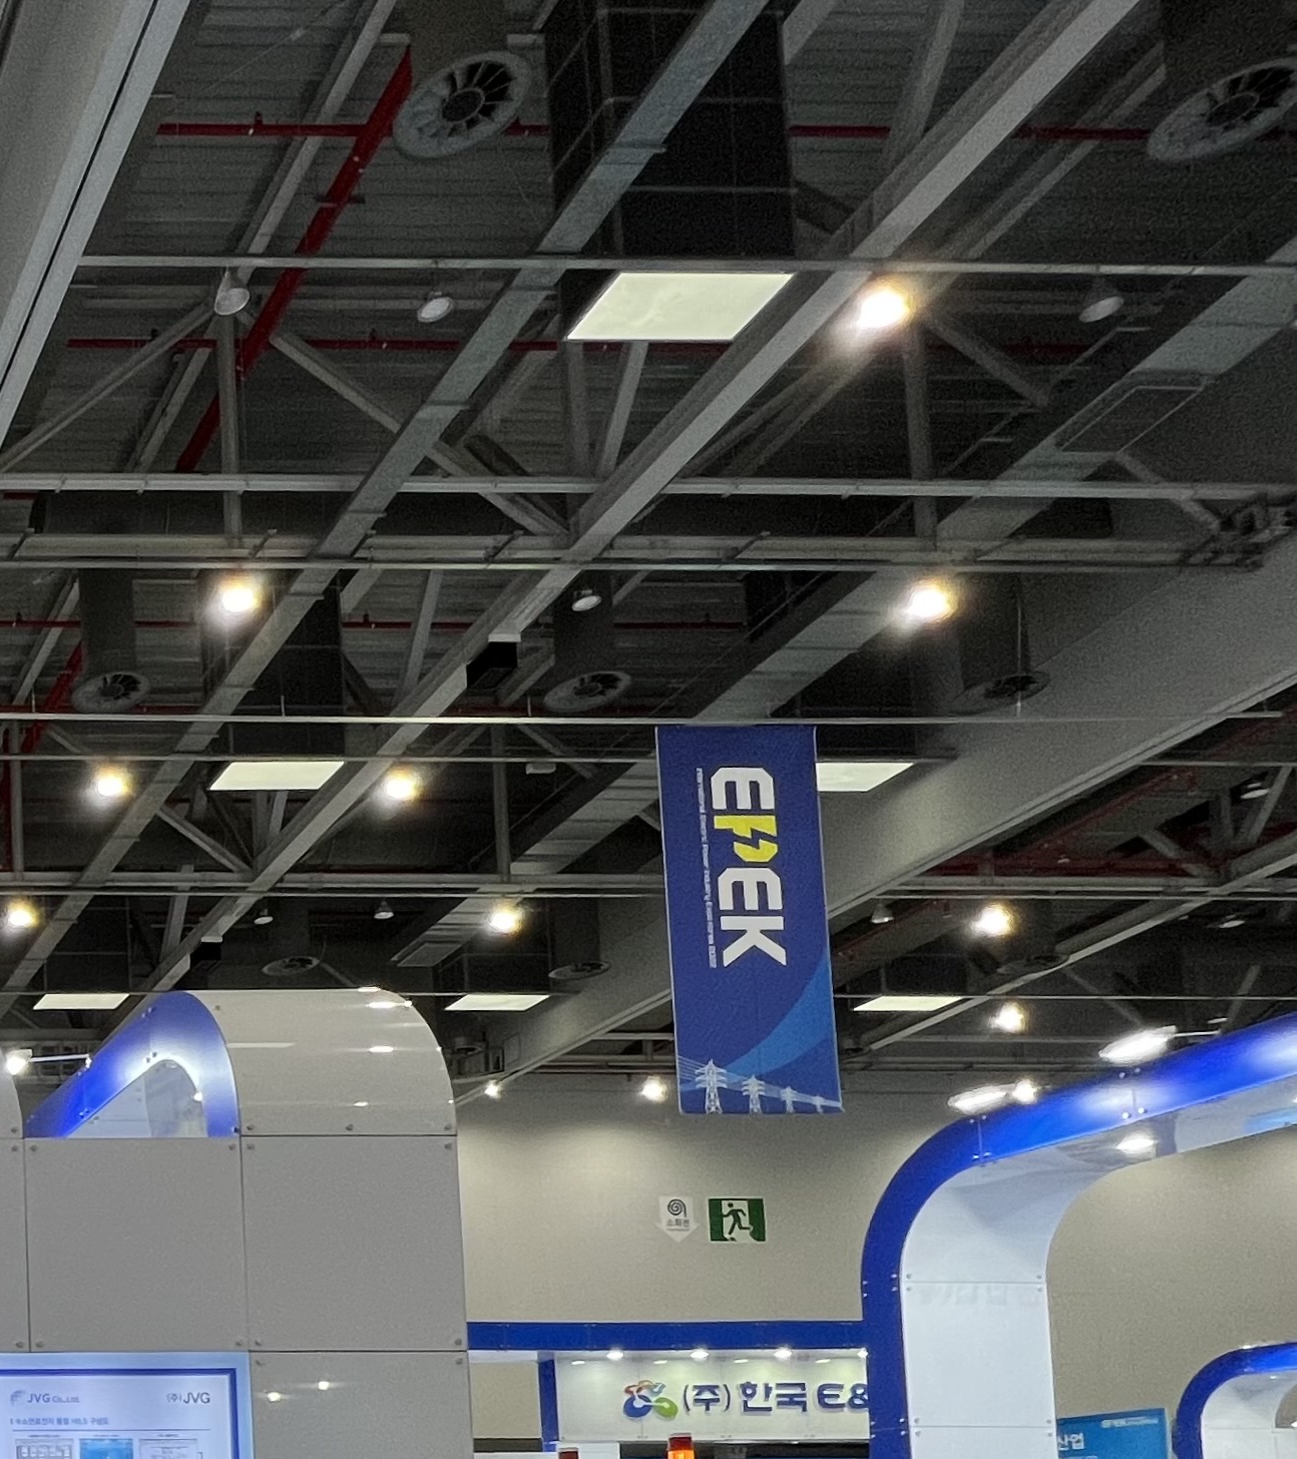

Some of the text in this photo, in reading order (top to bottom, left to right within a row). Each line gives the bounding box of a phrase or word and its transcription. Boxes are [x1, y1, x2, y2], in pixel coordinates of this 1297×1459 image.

[710, 766, 787, 966] EPEK
[27, 1393, 51, 1404] JVG
[683, 1384, 731, 1412] (주)
[739, 1381, 807, 1413] 한국
